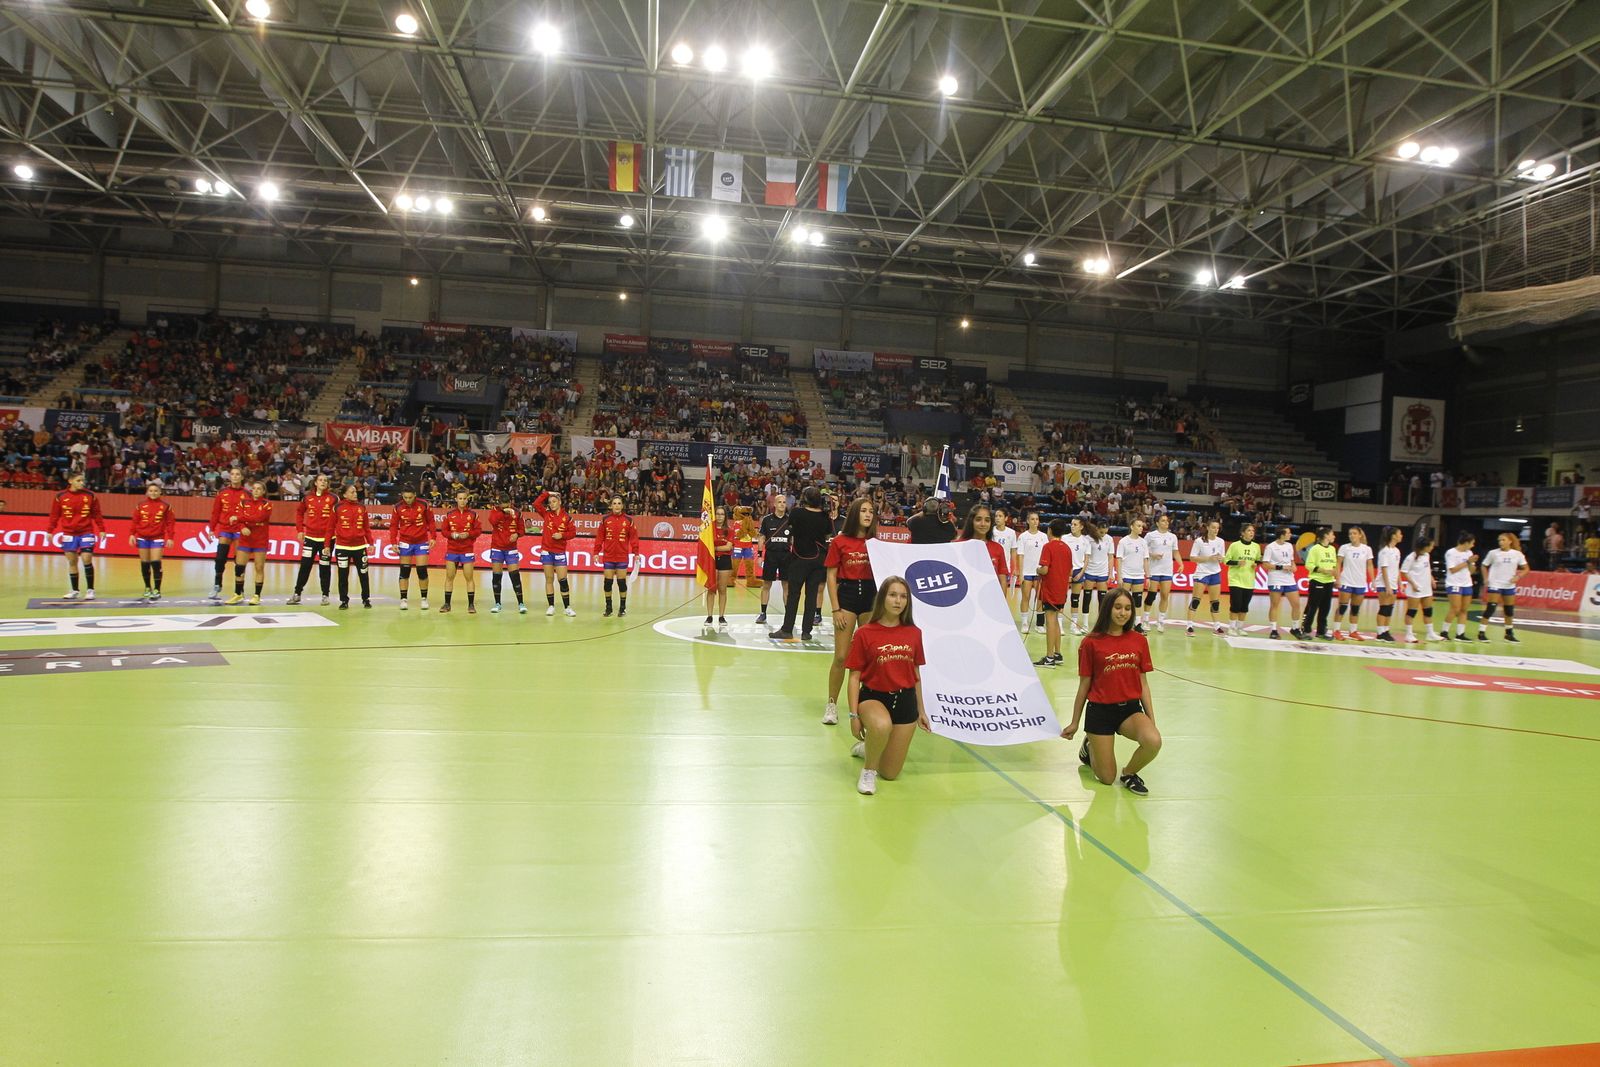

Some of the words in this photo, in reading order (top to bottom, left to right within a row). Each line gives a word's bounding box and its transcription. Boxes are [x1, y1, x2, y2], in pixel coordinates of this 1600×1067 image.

[920, 359, 947, 370] SER
[344, 428, 403, 446] AMBAR
[713, 448, 753, 456] DEPORTES
[1081, 470, 1131, 481] CLAUSE
[915, 571, 954, 590] EHF
[936, 692, 1018, 706] EUROPEAN
[941, 705, 1023, 719] HANDBALL
[930, 715, 1046, 732] CHAMPIONSHIP
